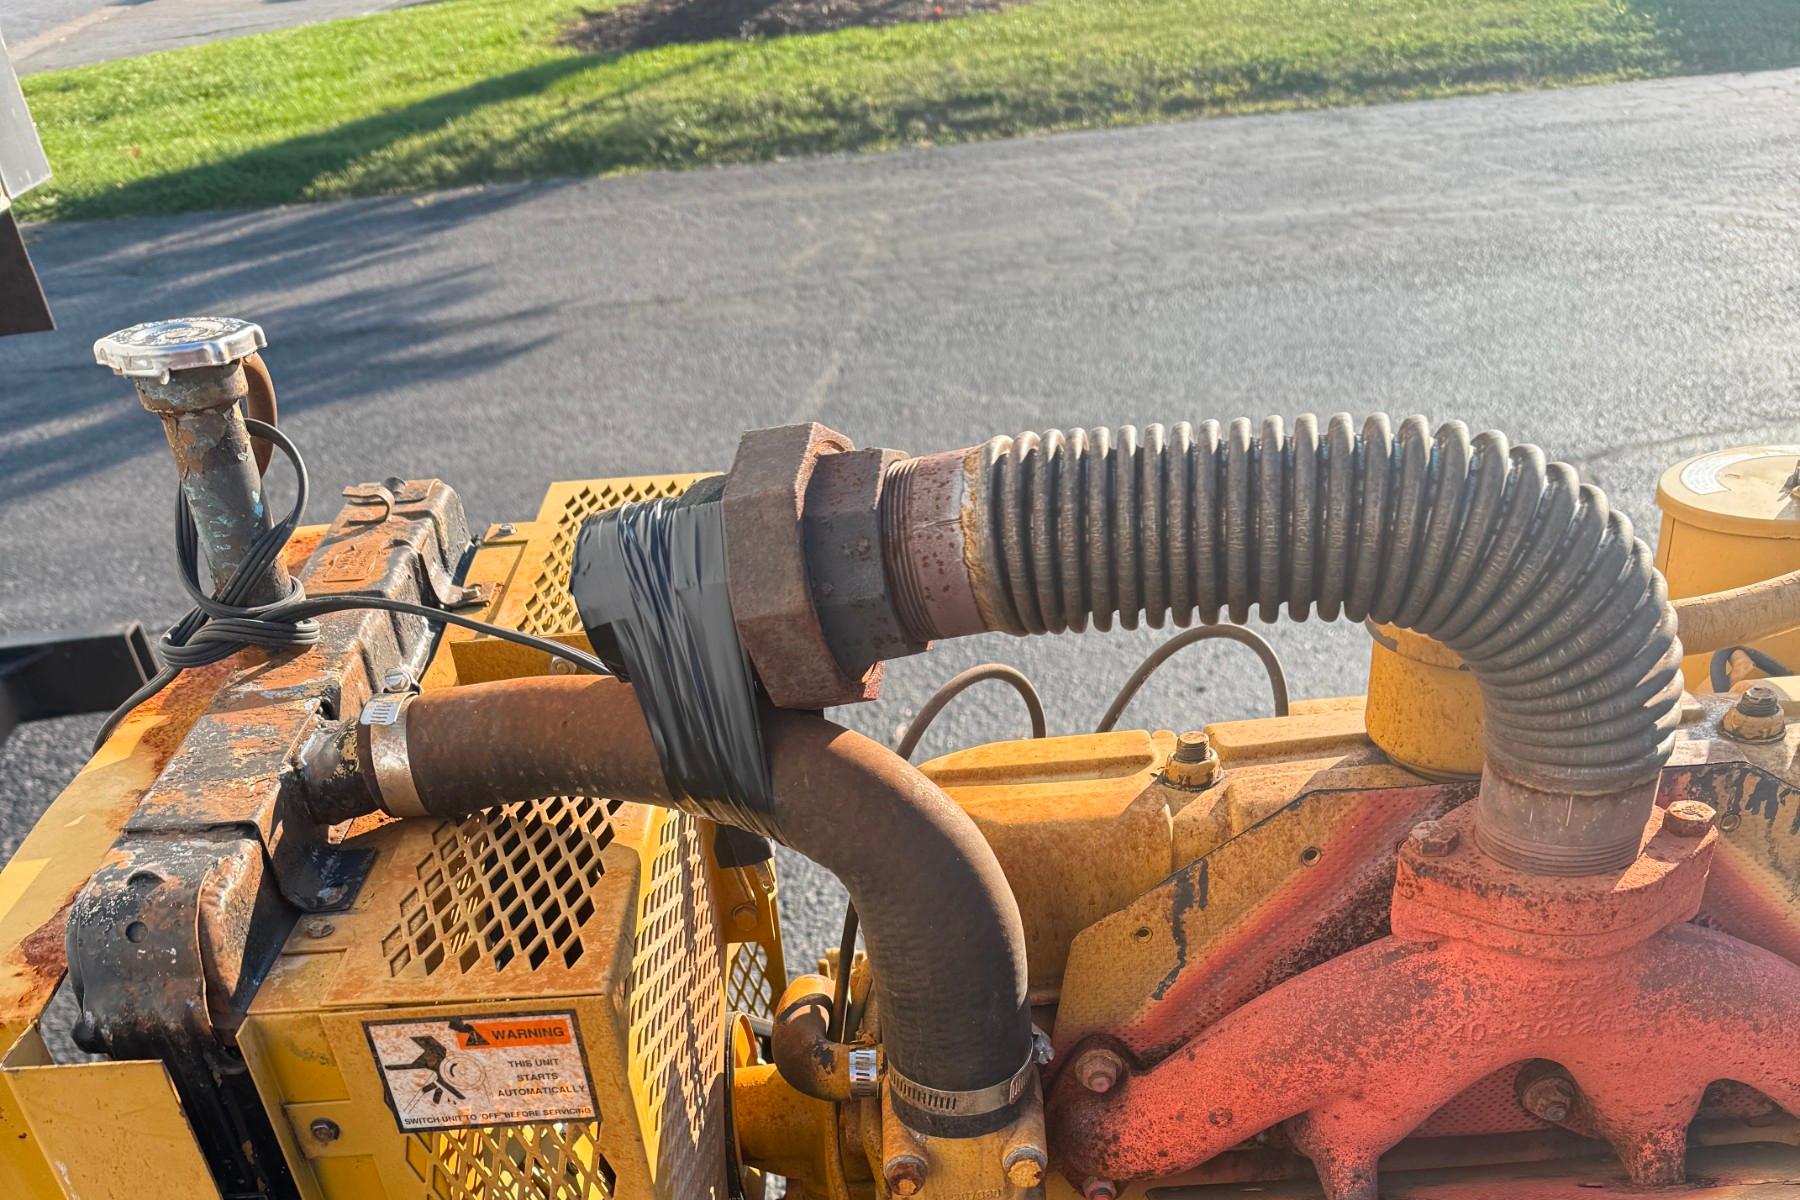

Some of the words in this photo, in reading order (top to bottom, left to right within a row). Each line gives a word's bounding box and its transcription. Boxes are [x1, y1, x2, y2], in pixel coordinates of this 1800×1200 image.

[491, 1025, 565, 1041] WARNING
[507, 1059, 533, 1068] THIS
[535, 1058, 561, 1067] UNIT
[516, 1072, 559, 1082] STARTS
[498, 1084, 587, 1097] AUTOMATICALLY
[404, 1114, 440, 1125] SWITCH
[441, 1113, 465, 1123] UNIT
[464, 1112, 477, 1121] TO
[504, 1109, 540, 1119] BEFORE
[542, 1106, 592, 1116] SERVICING
